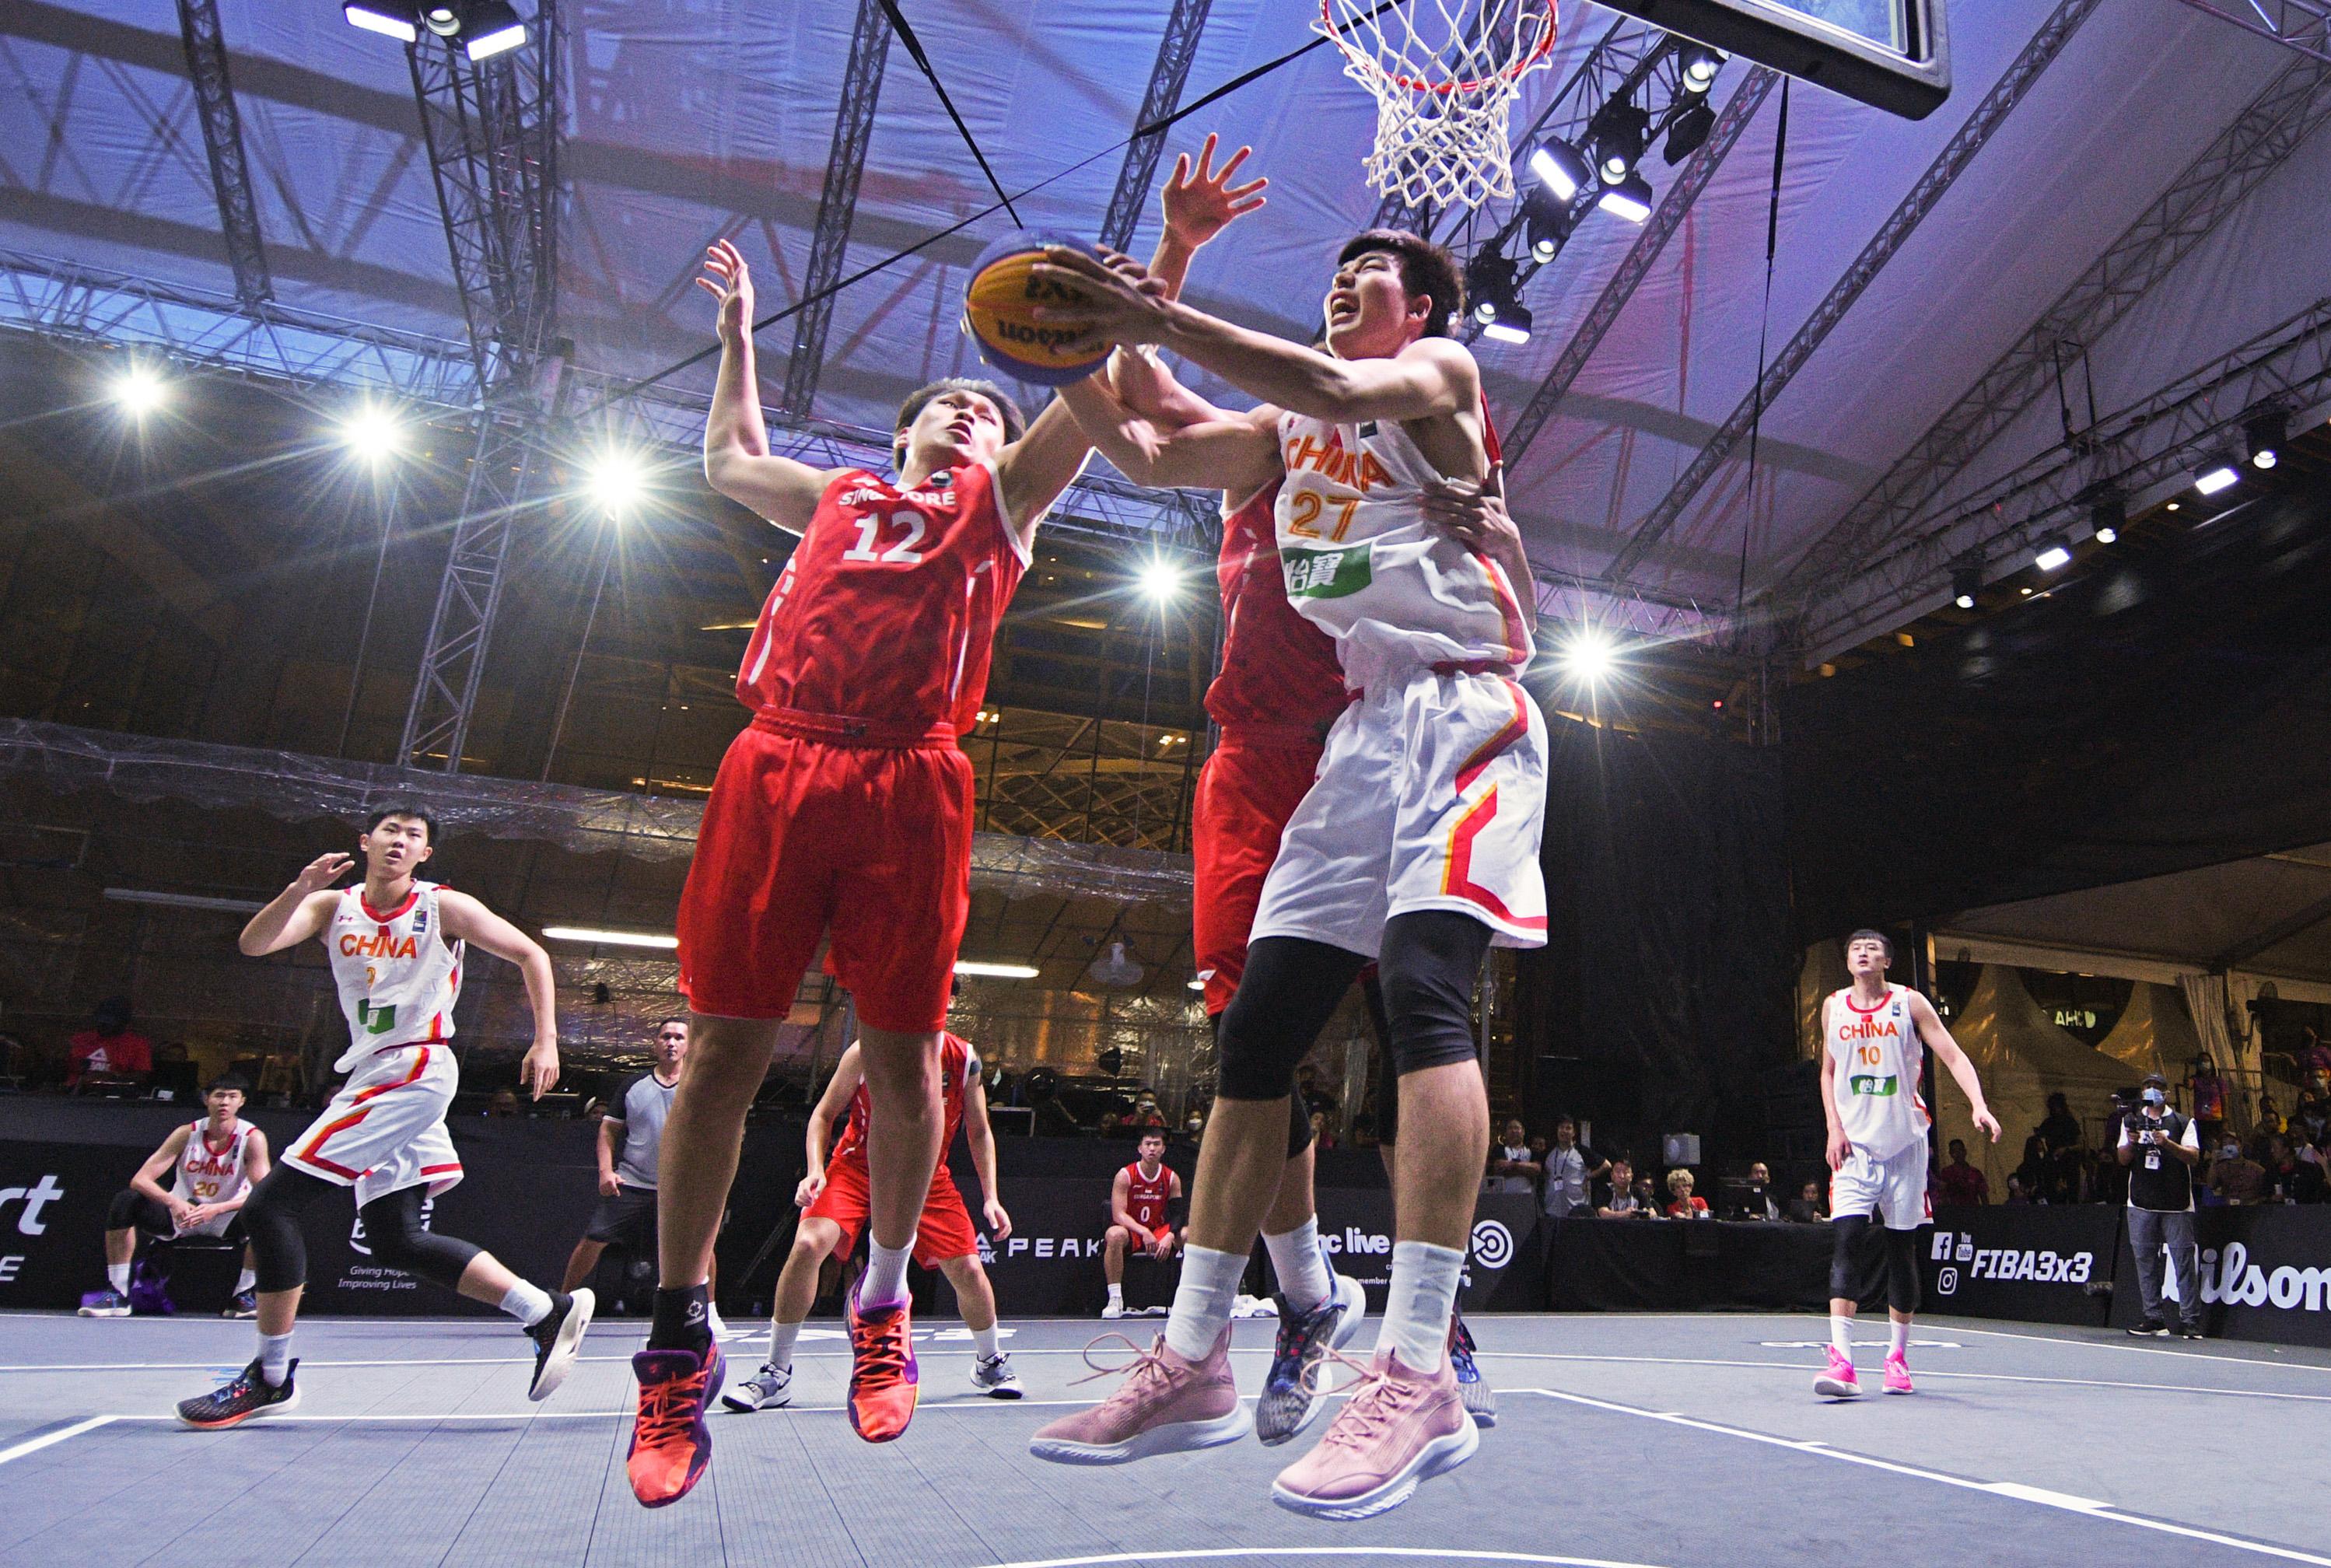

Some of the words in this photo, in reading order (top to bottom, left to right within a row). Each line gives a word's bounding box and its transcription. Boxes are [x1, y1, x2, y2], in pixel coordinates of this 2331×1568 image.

[1286, 436, 1398, 492] CHINA
[1289, 490, 1360, 542] 27
[843, 510, 926, 563] 12
[340, 934, 417, 959] CHINA
[1839, 1020, 1899, 1041] CHINA
[1857, 1045, 1881, 1066] 10
[186, 1160, 234, 1176] CHINA
[193, 1181, 219, 1197] 20
[1140, 1206, 1150, 1223] 0
[1008, 1238, 1104, 1258] PEAK
[1346, 1227, 1391, 1254] live
[350, 1266, 383, 1278] Giving
[1970, 1249, 2093, 1283] FIBA3x3
[338, 1279, 390, 1290] Improving
[392, 1279, 418, 1290] Lives
[1358, 1276, 1388, 1285] member
